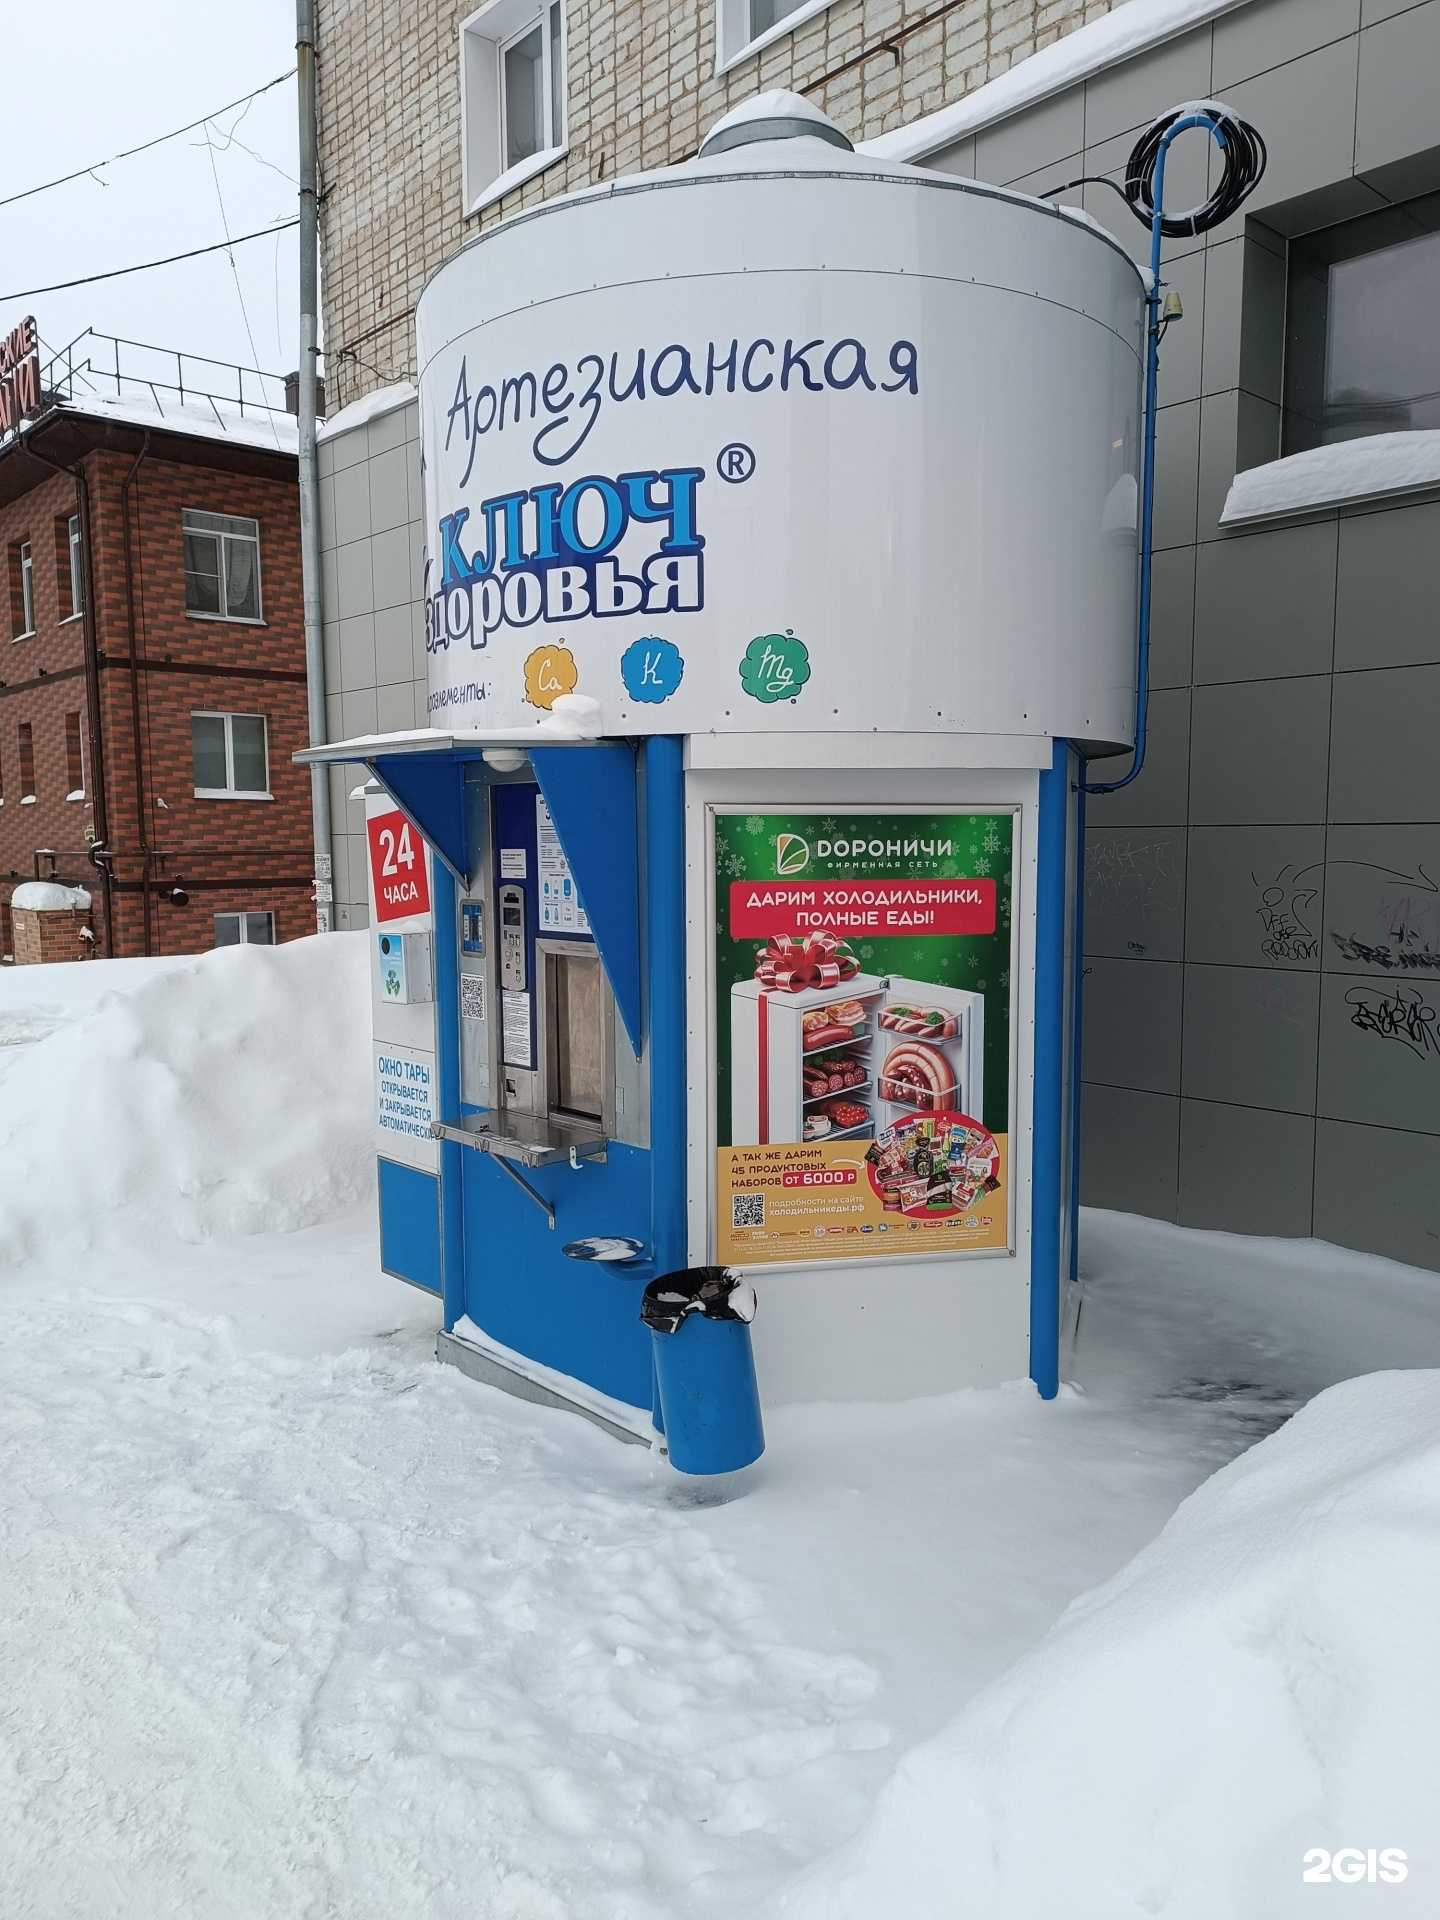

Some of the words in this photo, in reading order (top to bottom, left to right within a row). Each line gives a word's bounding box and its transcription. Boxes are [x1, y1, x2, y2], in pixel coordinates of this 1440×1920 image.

[446, 338, 919, 488] Артезианская
[538, 658, 563, 692] Ca
[757, 643, 795, 693] Mg
[379, 822, 415, 877] 24
[827, 861, 901, 869] ФИРМЕННАЯ
[908, 860, 939, 869] СЕТЬ
[383, 881, 419, 905] ЧАСА
[746, 891, 816, 909] ДАРИМ
[823, 888, 983, 907] ХОЛОДИЛЬНИКИ,
[796, 911, 879, 927] ПОЛНЫЕ
[886, 910, 935, 927] ЕДЫ!
[378, 1056, 403, 1078] ОКНО
[404, 1062, 430, 1085] ТАРЫ
[381, 1080, 428, 1104] ОТКРЫВАЕТСЯ
[385, 1098, 432, 1122] ЗАКРЫВАЕТСЯ
[731, 1154, 739, 1162] А
[743, 1152, 761, 1161] ТАК
[765, 1151, 781, 1160] ЖЕ
[785, 1150, 822, 1160] ДАРИМ
[731, 1177, 782, 1188] НАБОРОВ
[803, 1171, 844, 1184] 6000
[732, 1167, 745, 1175] 45
[749, 1162, 827, 1174] ПРОДУКТОВЫХ
